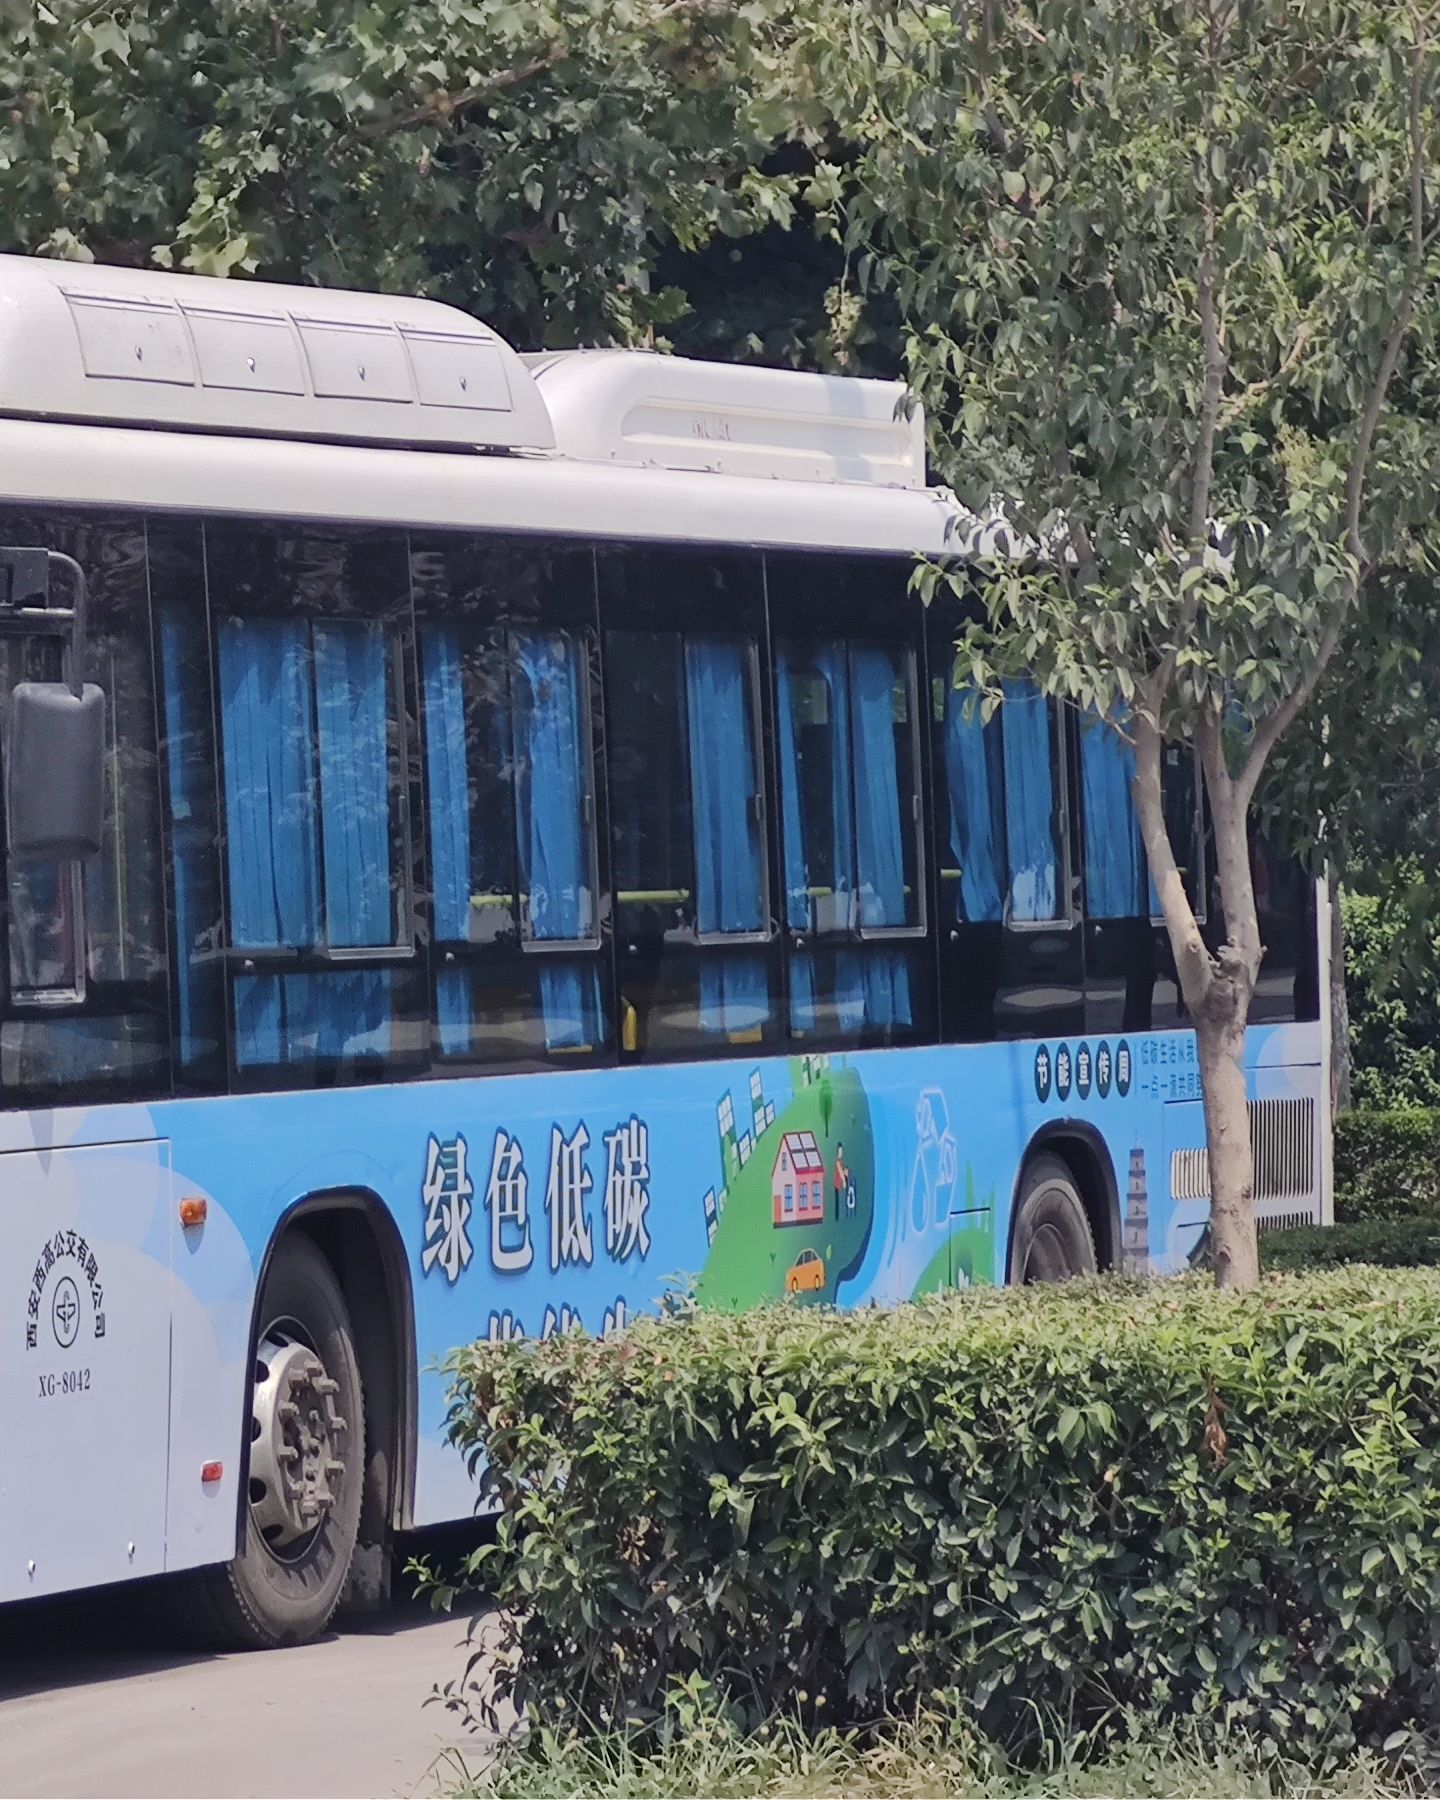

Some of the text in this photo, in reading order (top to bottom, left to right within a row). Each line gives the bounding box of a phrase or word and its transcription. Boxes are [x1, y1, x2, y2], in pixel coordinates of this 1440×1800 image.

[421, 1112, 652, 1286] 绿色低碳
[26, 1228, 106, 1351] 西安西高公交有限公司
[38, 1368, 91, 1398] XG-8042
